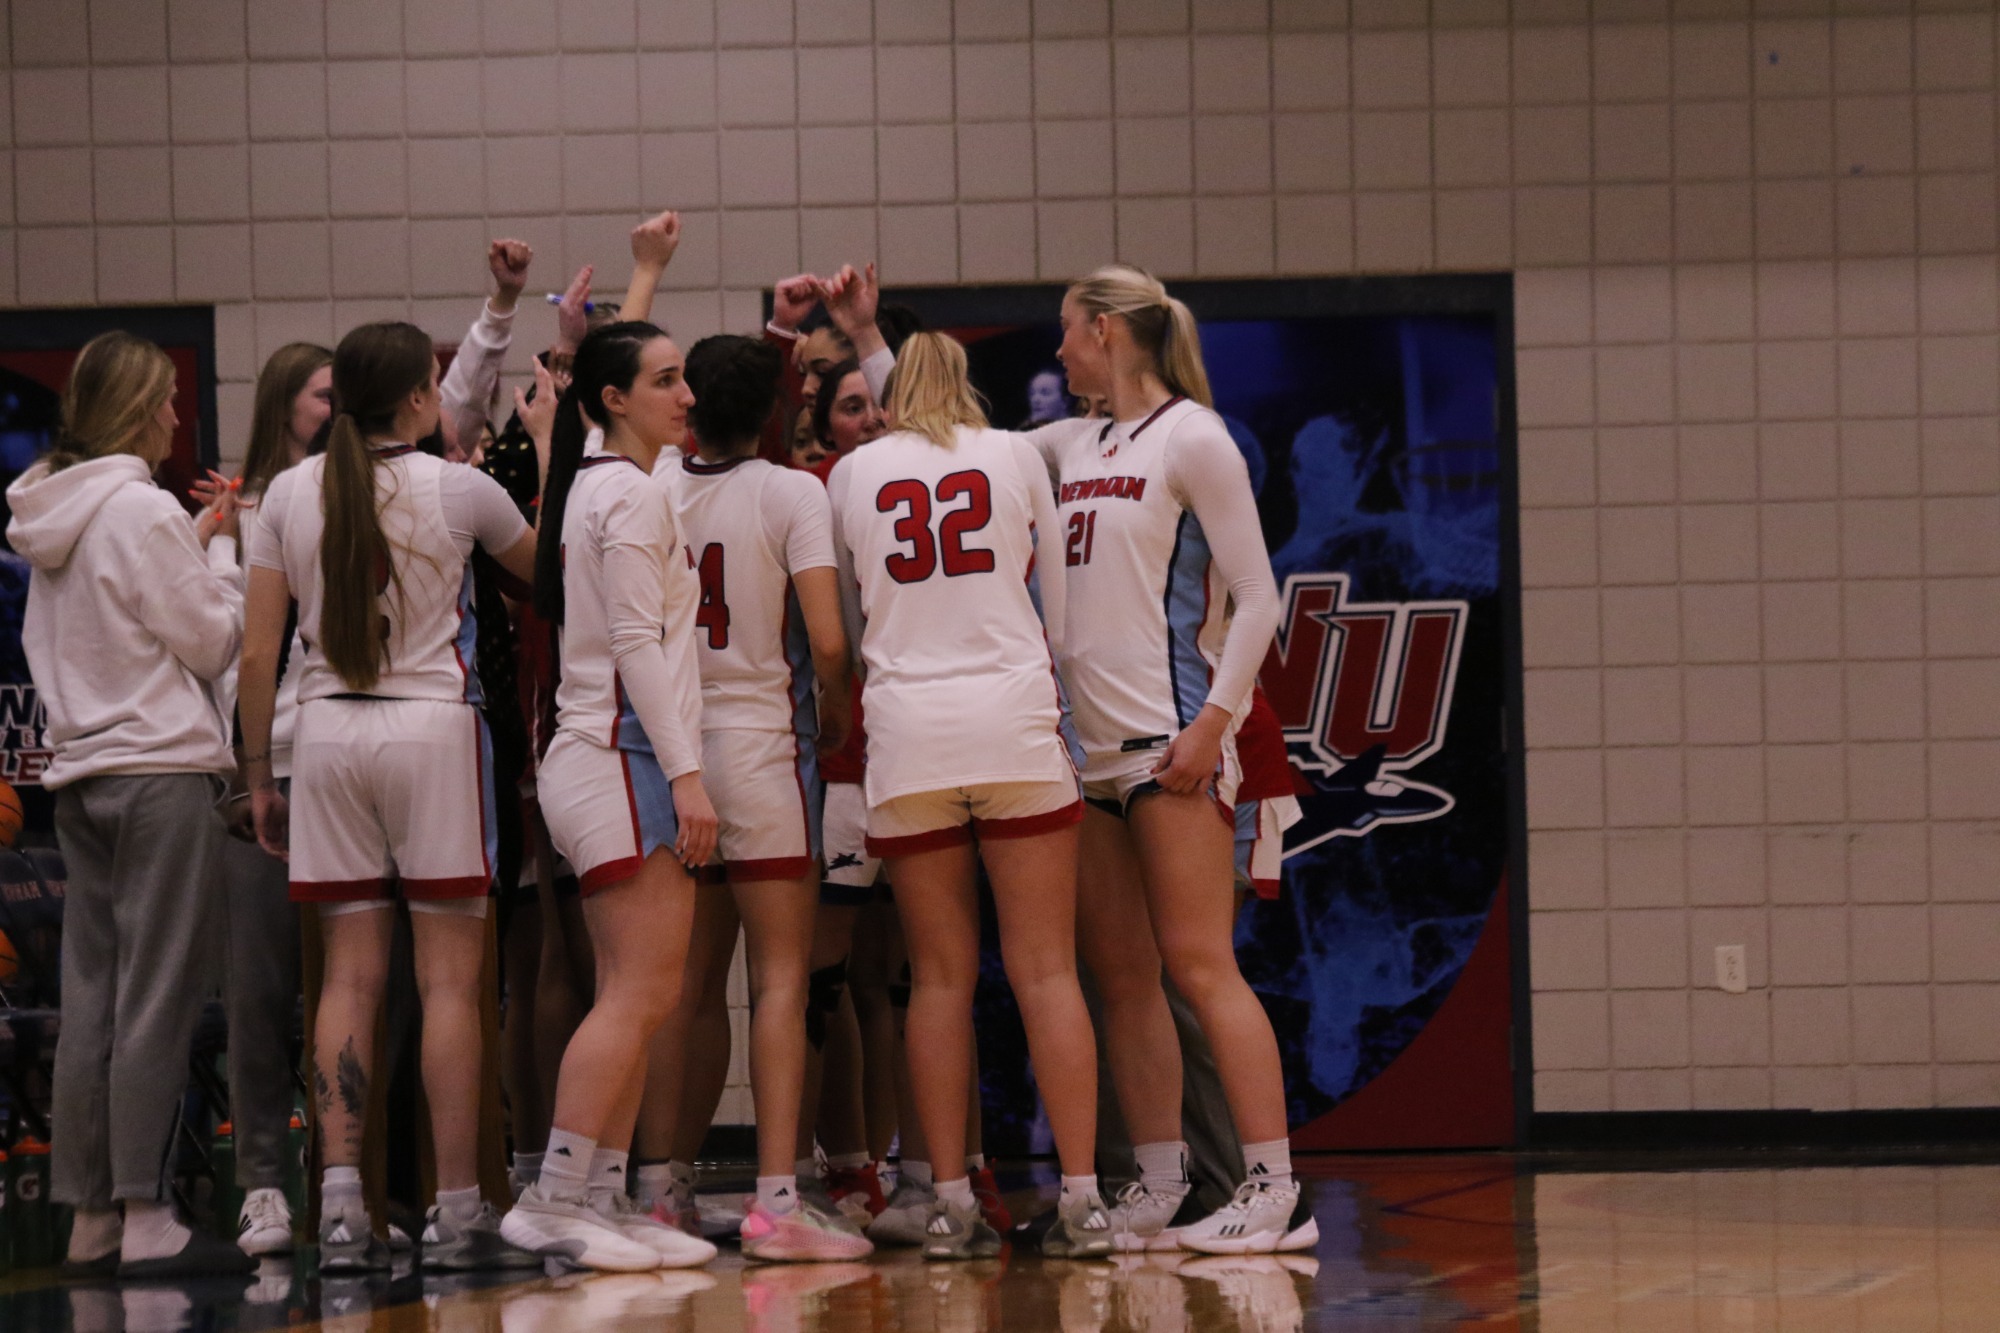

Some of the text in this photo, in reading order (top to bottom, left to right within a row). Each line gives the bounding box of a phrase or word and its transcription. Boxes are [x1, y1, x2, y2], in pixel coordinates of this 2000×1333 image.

[1060, 476, 1147, 504] NEWMAN
[876, 469, 995, 584] 32
[1066, 510, 1097, 567] 21
[696, 542, 730, 650] 4
[16, 1173, 40, 1200] G
